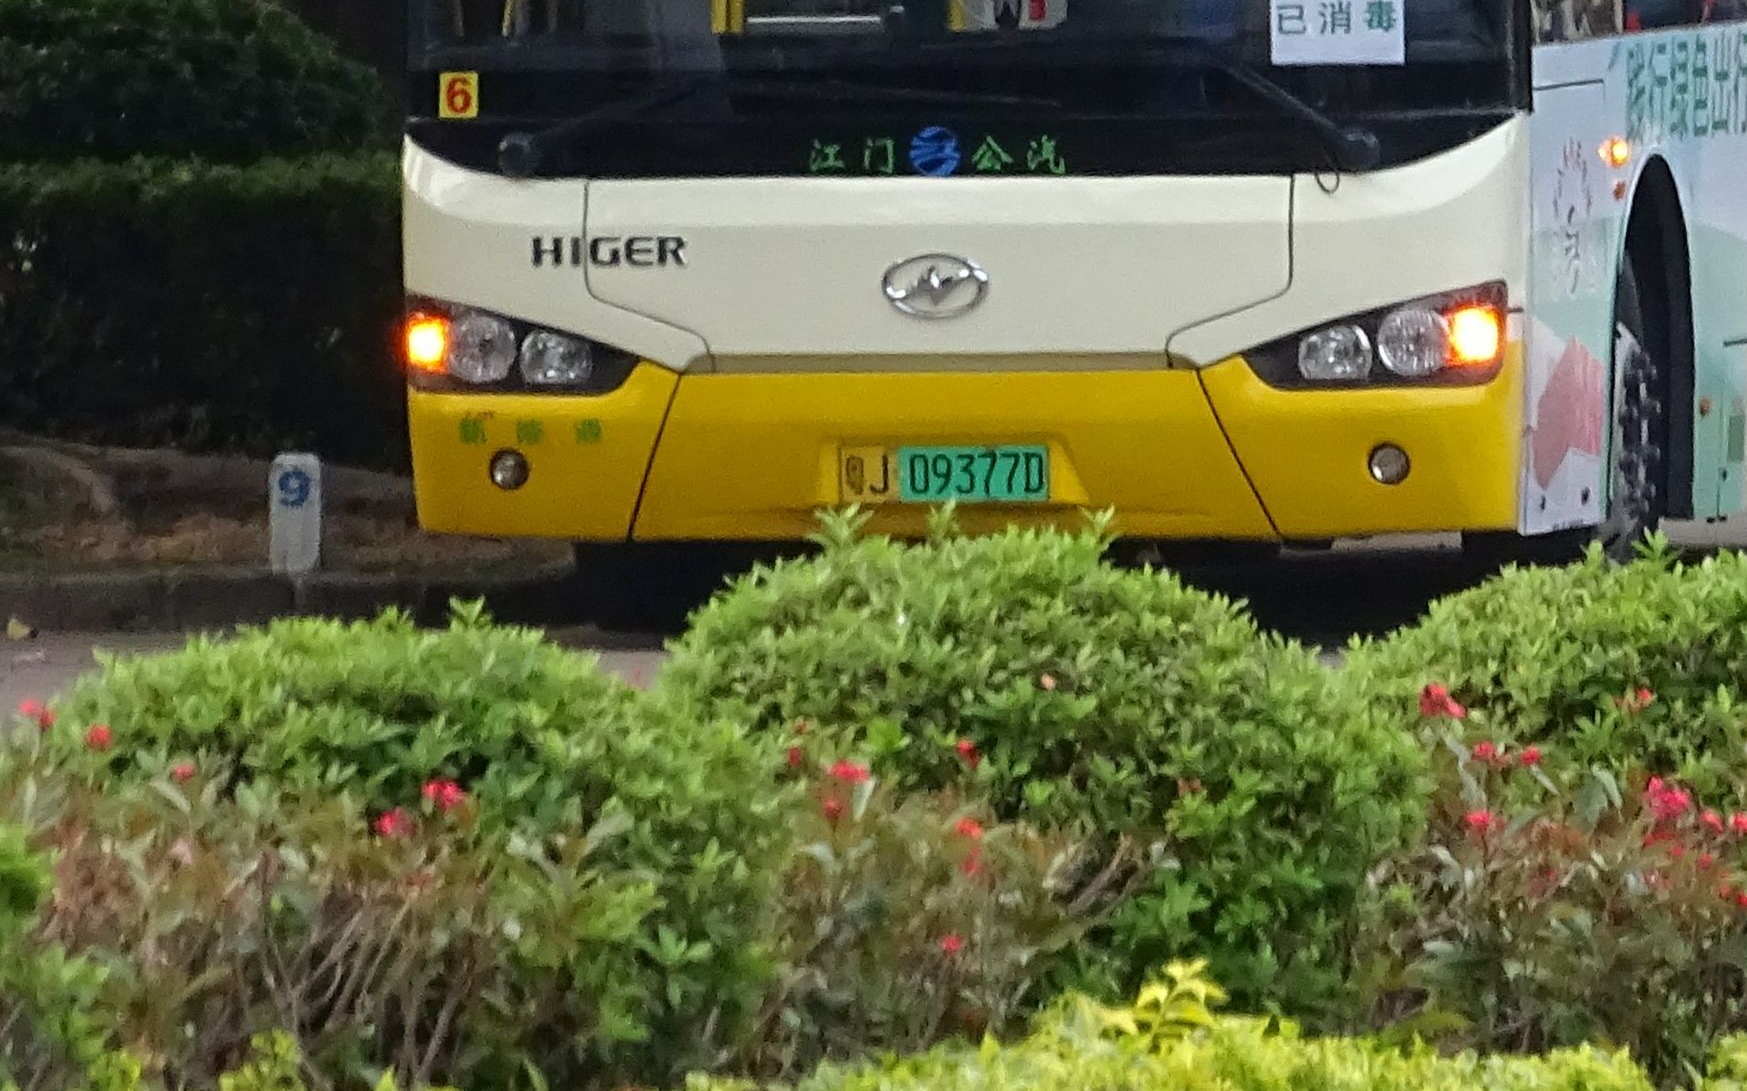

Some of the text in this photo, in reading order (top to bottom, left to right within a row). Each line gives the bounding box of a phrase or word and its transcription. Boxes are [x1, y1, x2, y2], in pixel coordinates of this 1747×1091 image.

[1276, 0, 1397, 36] 已消毒
[447, 76, 472, 114] 6
[532, 236, 688, 268] HIGER
[278, 468, 311, 508] 9
